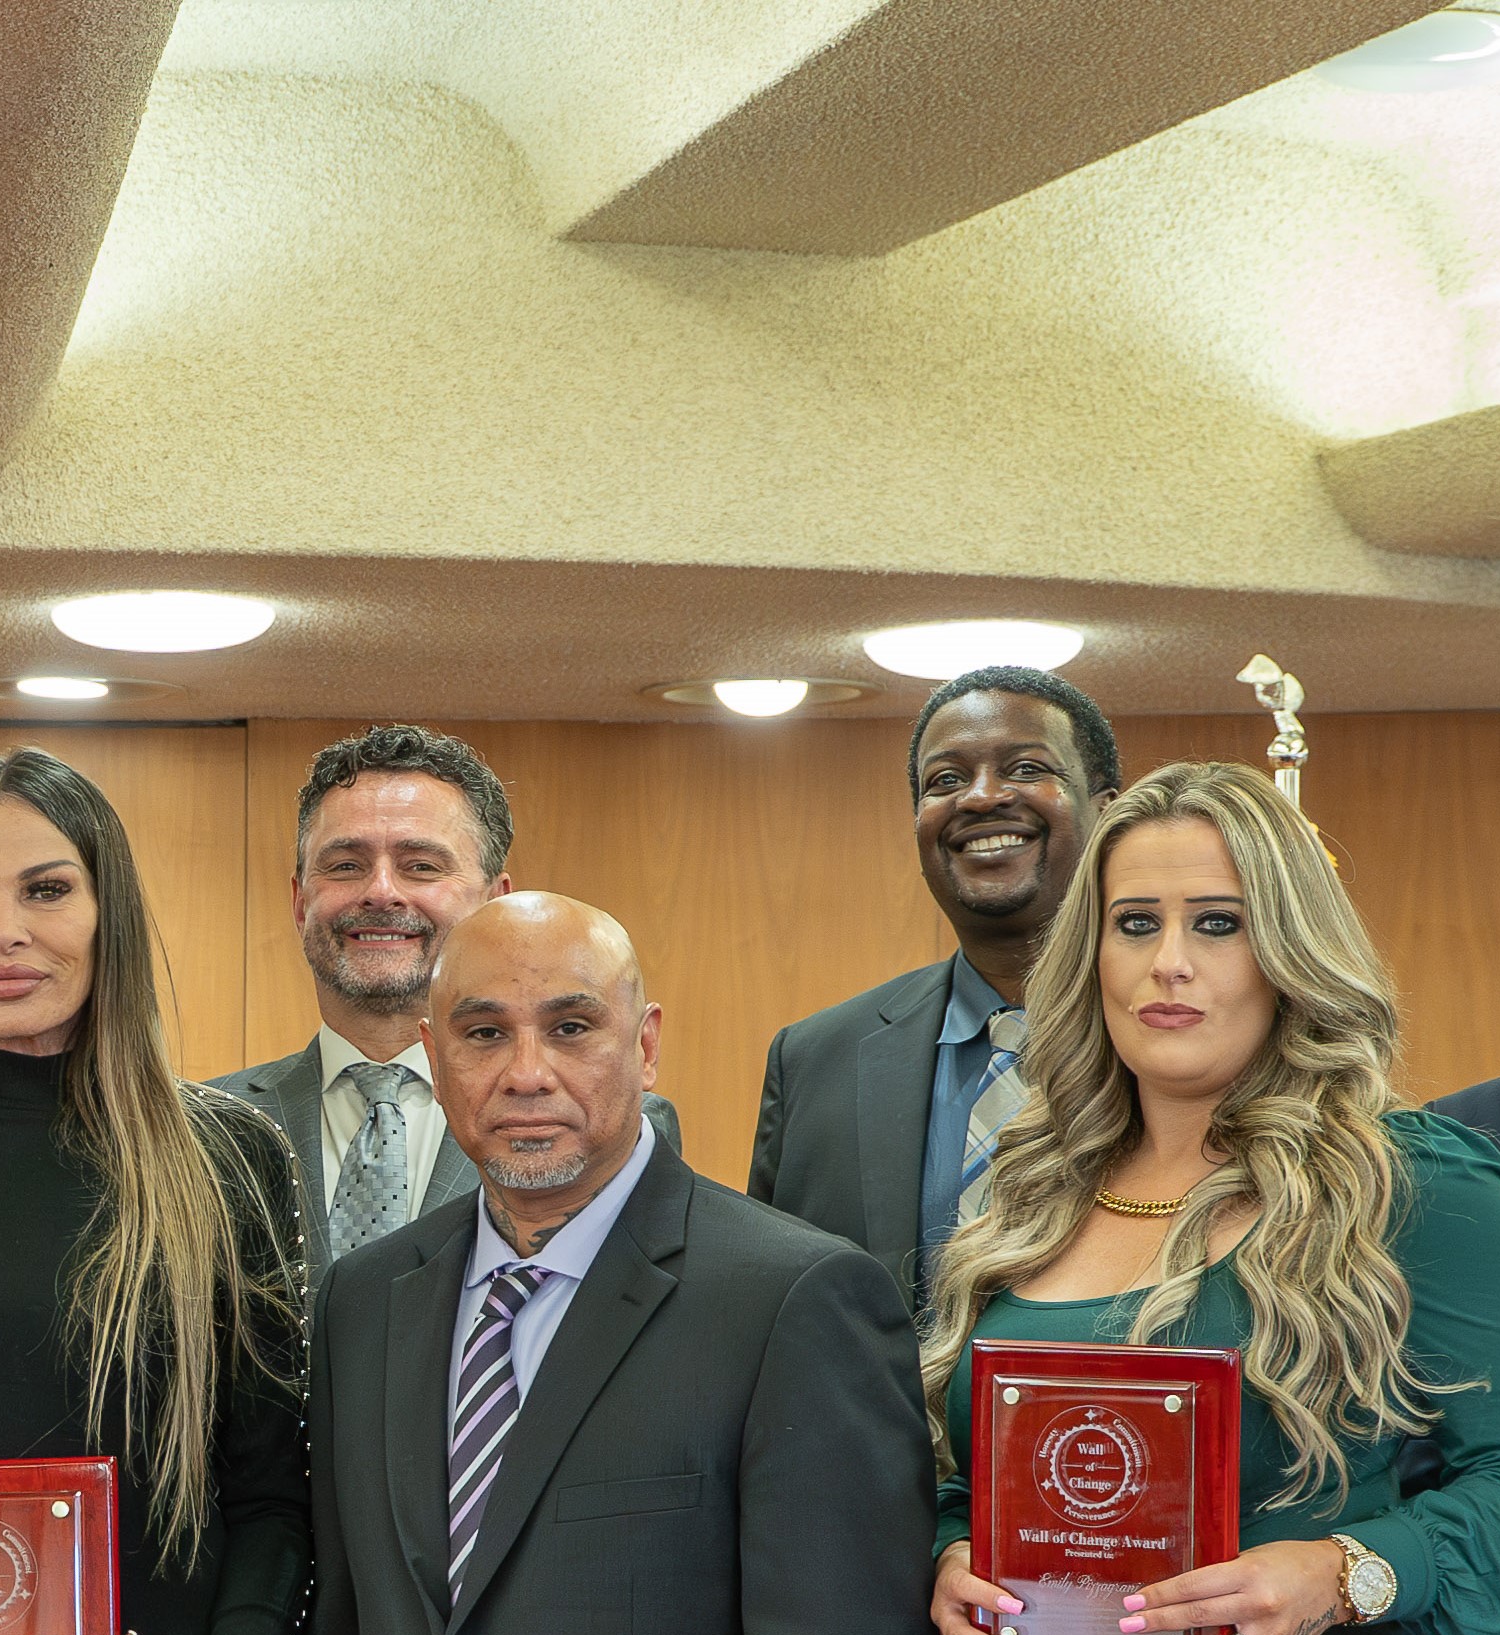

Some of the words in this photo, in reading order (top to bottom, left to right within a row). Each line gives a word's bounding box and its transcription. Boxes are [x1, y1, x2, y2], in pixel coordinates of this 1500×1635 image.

[1039, 1428, 1059, 1458] Honesty
[1077, 1443, 1104, 1455] Wall
[1113, 1419, 1142, 1468] Commitment
[1085, 1462, 1095, 1471] of
[1069, 1478, 1112, 1493] Change
[1064, 1505, 1117, 1521] Perseverance
[1019, 1529, 1049, 1543] Wall
[1053, 1533, 1065, 1544] of
[1069, 1532, 1118, 1550] Change
[1123, 1537, 1166, 1550] Award
[3, 1529, 32, 1574] Commitment
[1065, 1549, 1102, 1558] Presented
[1039, 1572, 1073, 1593] Emily
